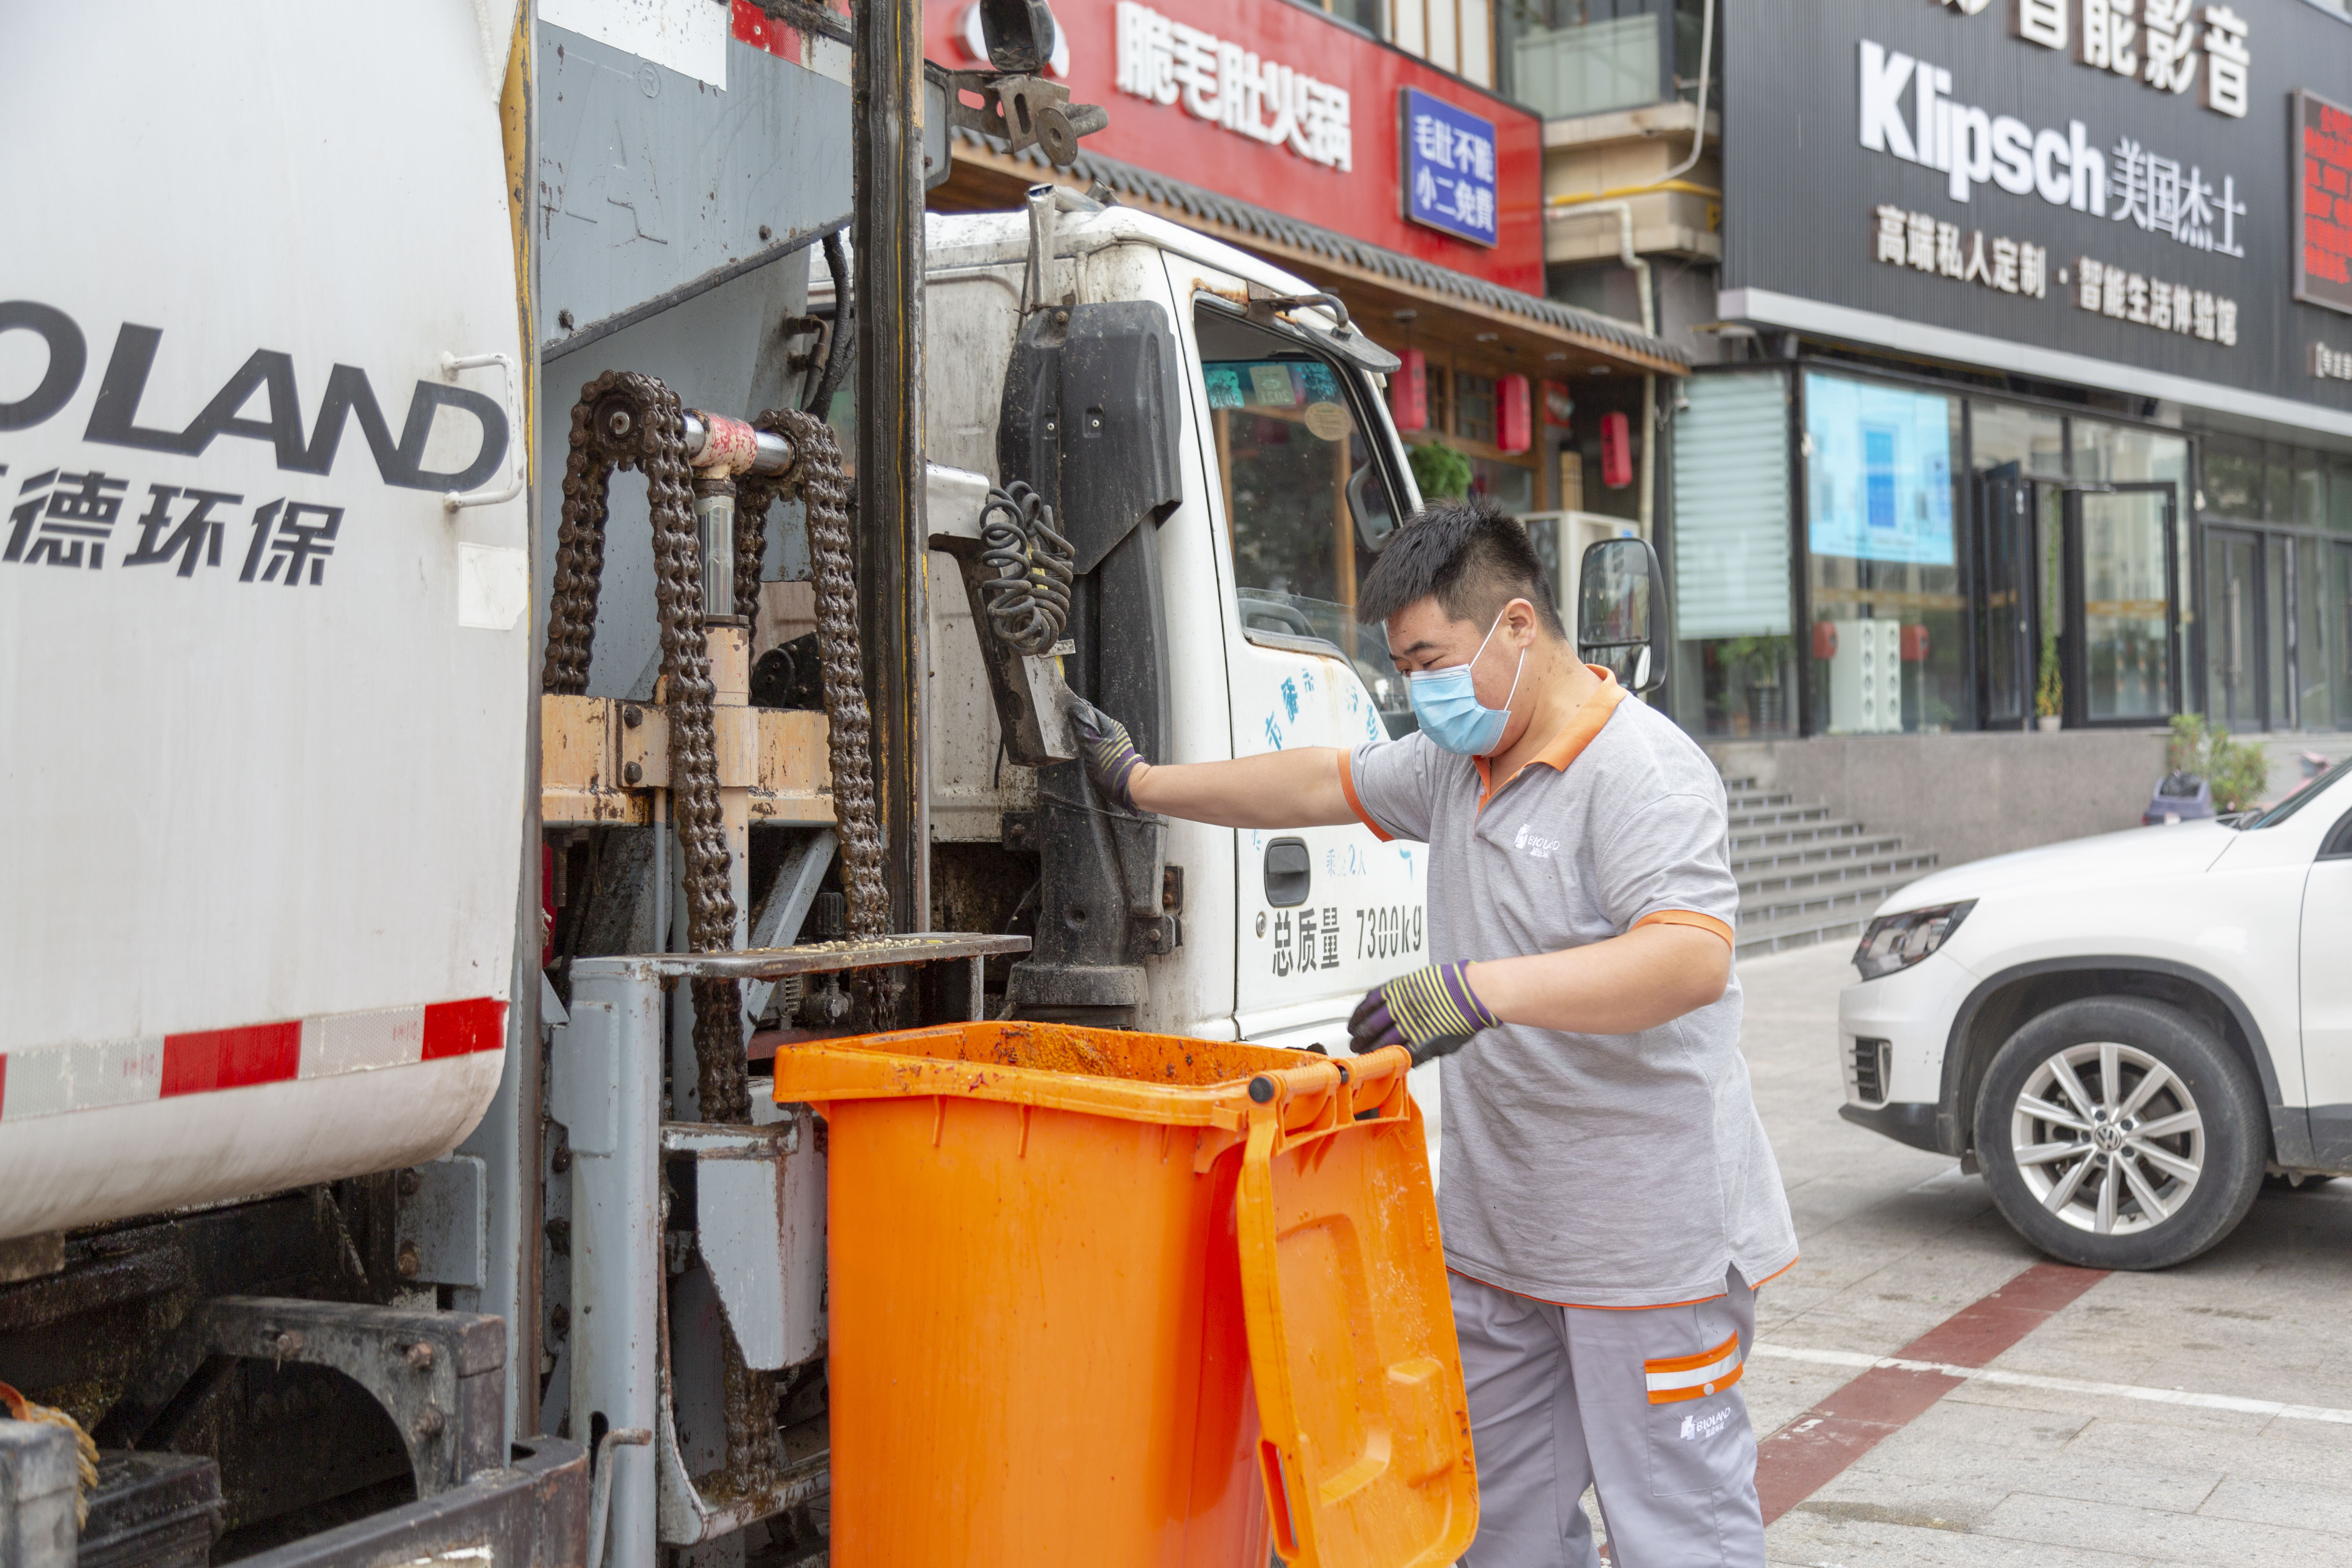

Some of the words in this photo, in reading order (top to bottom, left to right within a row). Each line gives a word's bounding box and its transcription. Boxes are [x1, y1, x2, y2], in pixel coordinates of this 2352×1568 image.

[1116, 0, 1352, 173] 脆毛肚火锅
[1860, 38, 2106, 218] Klipsch
[2111, 136, 2246, 258] 美国杰士
[0, 464, 345, 586] 德环保
[1272, 907, 1340, 977] 总质量
[1356, 905, 1422, 960] 7300kg
[1696, 1407, 1731, 1432] BIOLAND
